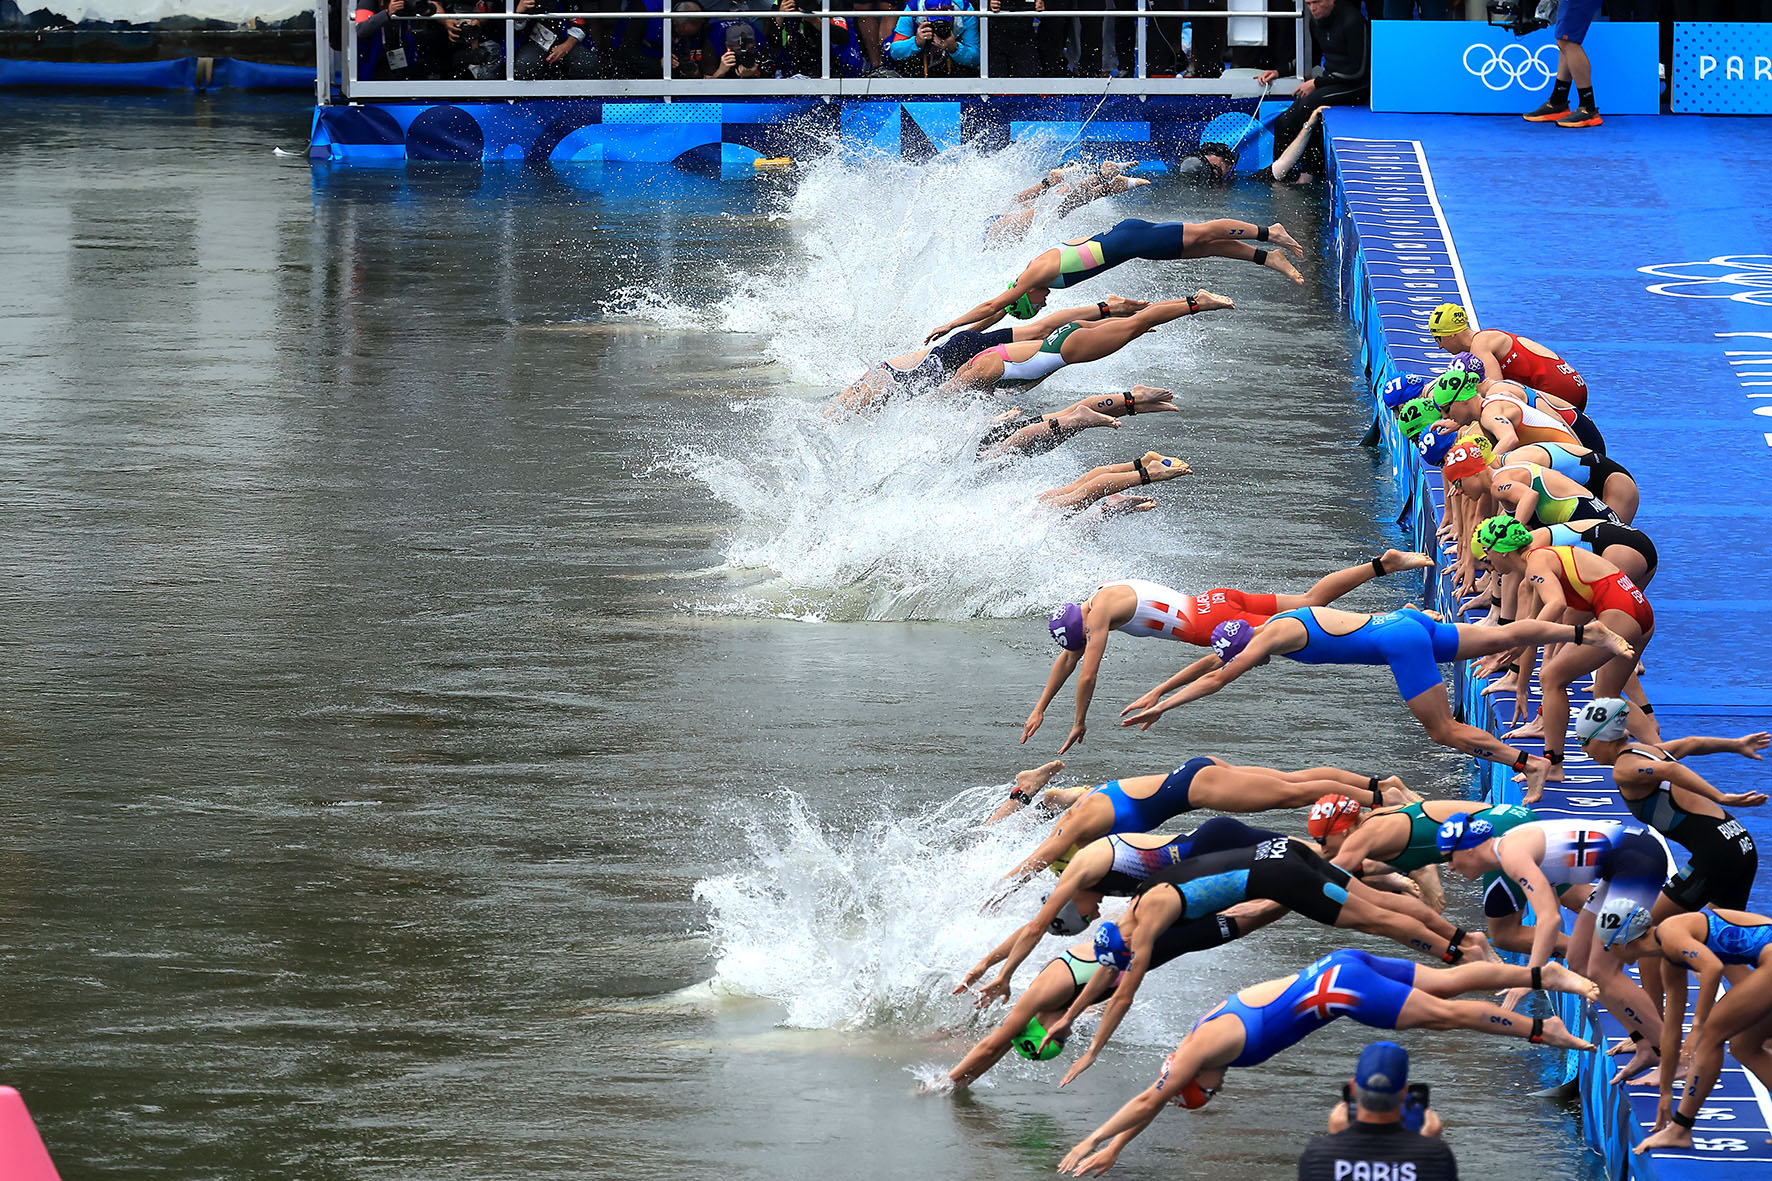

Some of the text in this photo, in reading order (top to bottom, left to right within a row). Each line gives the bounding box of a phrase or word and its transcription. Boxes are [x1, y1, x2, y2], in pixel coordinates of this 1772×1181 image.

[1700, 55, 1772, 81] PAR
[1434, 311, 1444, 324] 7
[1384, 376, 1402, 394] 37
[1438, 376, 1462, 391] 49
[1097, 397, 1114, 408] 20
[1400, 405, 1422, 424] 42
[1419, 432, 1436, 457] 39
[1446, 447, 1468, 467] 23
[1584, 705, 1608, 723] 18
[1310, 801, 1335, 821] 29
[1440, 821, 1464, 839] 31
[1519, 877, 1535, 893] 31
[1600, 912, 1621, 930] 12
[1489, 1014, 1513, 1027] 22
[1624, 1006, 1643, 1025] 31
[1688, 1075, 1700, 1097] 12
[1691, 1137, 1750, 1152] 55
